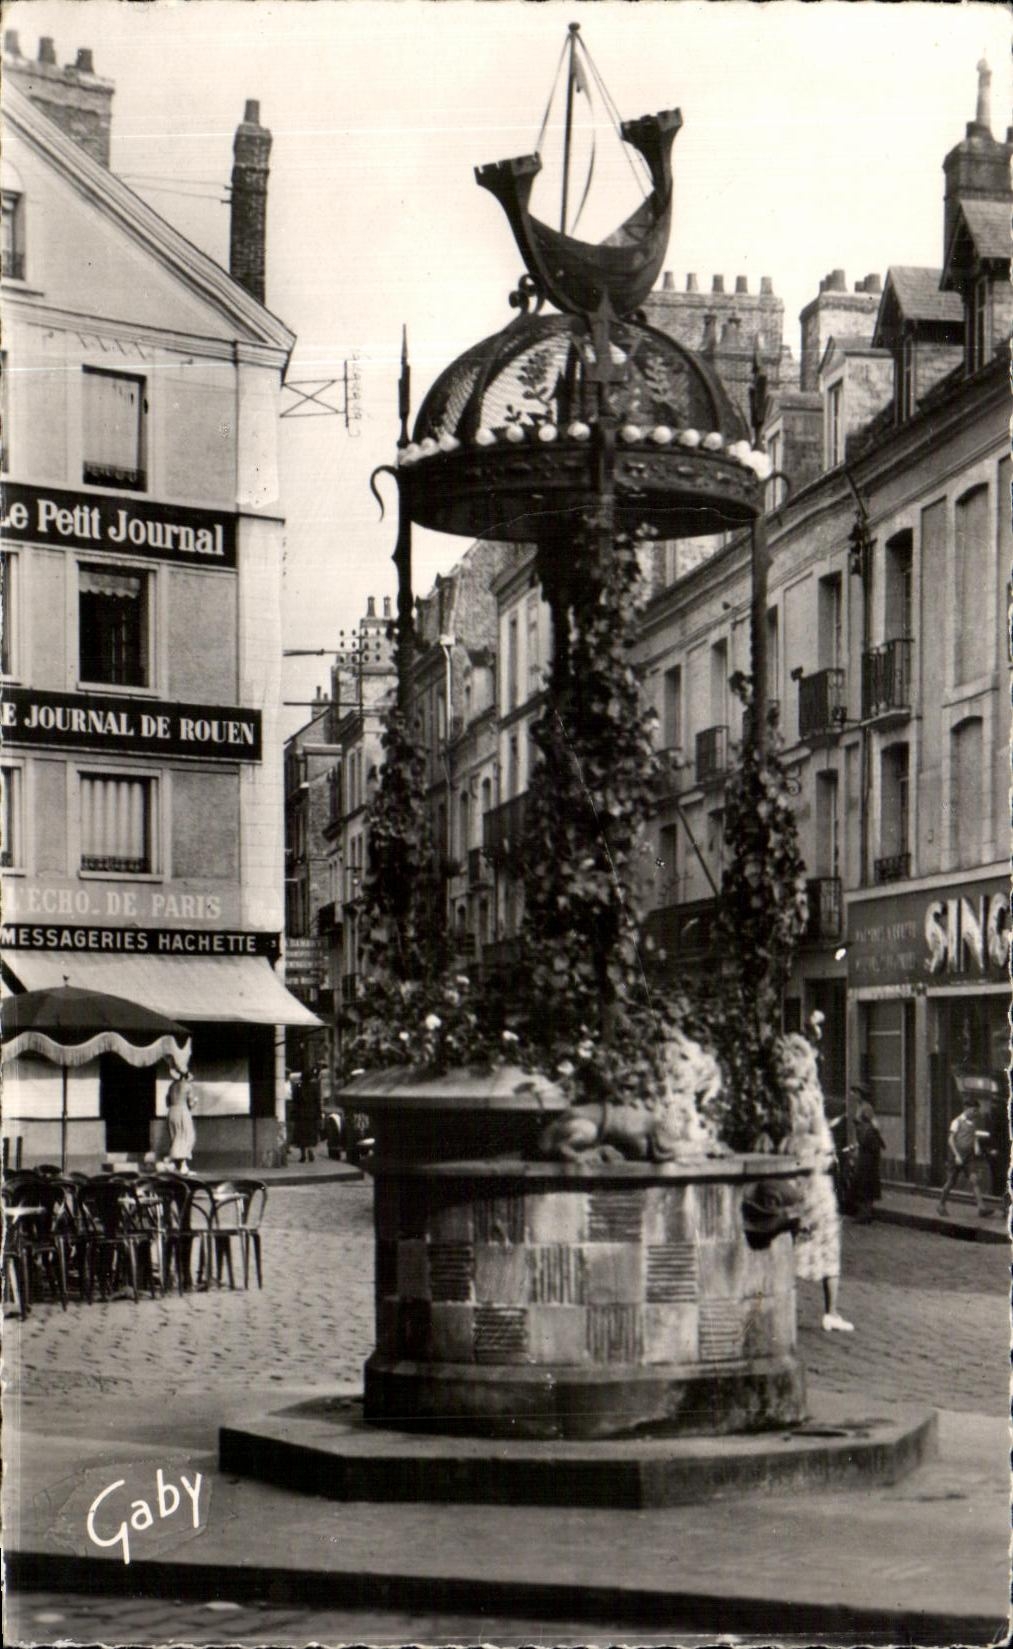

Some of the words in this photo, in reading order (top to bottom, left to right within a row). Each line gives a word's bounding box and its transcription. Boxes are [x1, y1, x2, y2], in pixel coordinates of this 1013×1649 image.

[0, 502, 28, 529] e
[37, 499, 101, 540] Petit
[108, 510, 224, 556] Journal
[24, 704, 135, 737] JOURNAL
[140, 714, 171, 740] DE
[179, 718, 254, 745] ROUEN
[106, 891, 136, 917] DE
[152, 894, 222, 920] PARIS
[1, 928, 148, 950] MESSAGERIES
[158, 932, 256, 952] HACHETTE
